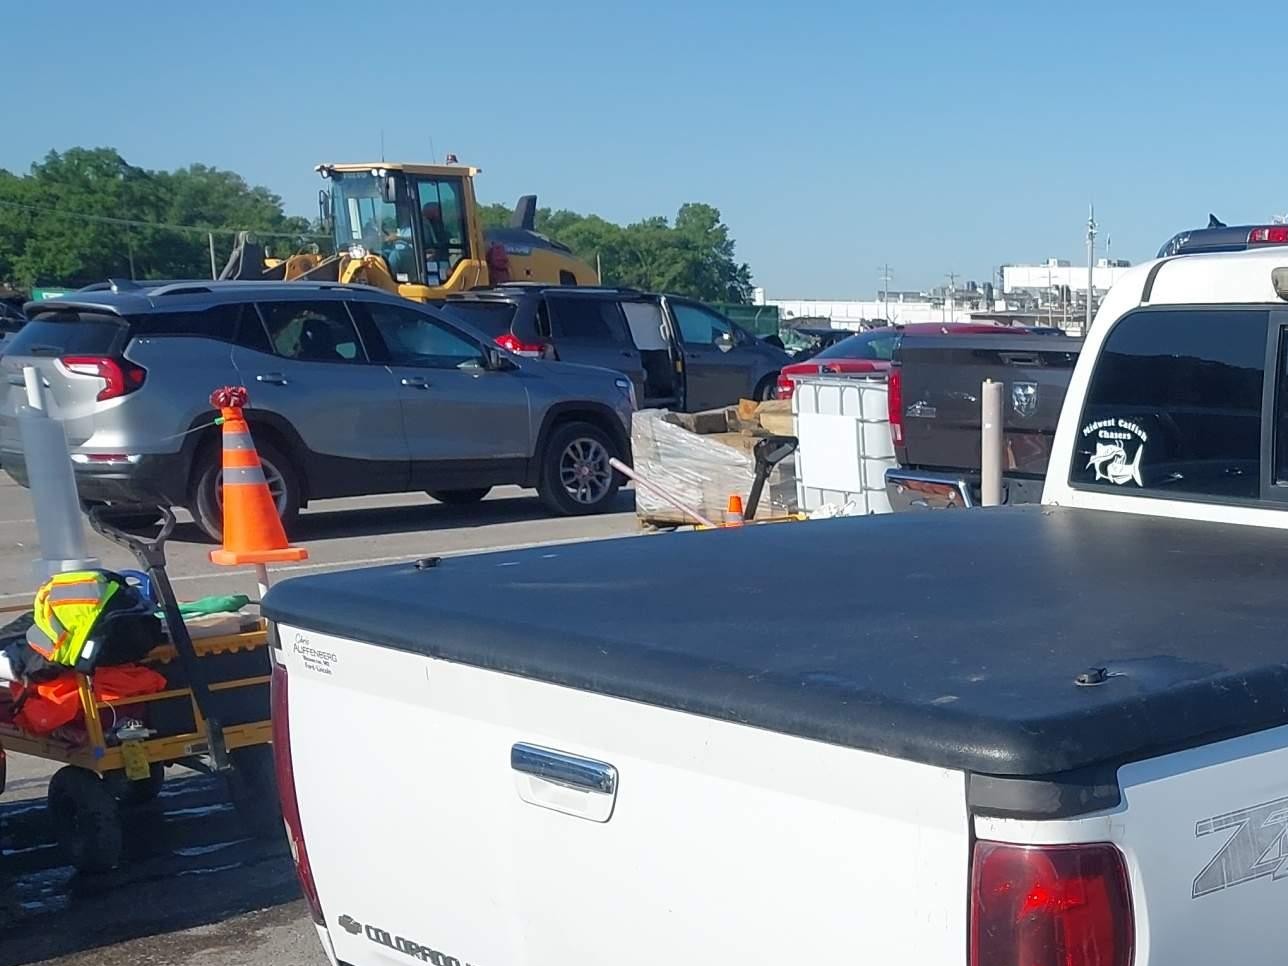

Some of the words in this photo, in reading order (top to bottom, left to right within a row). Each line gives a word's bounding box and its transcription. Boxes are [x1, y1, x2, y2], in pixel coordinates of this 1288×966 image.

[1083, 418, 1115, 437] Midwest
[1118, 419, 1147, 442] Catfish
[1098, 429, 1132, 440] Chasers
